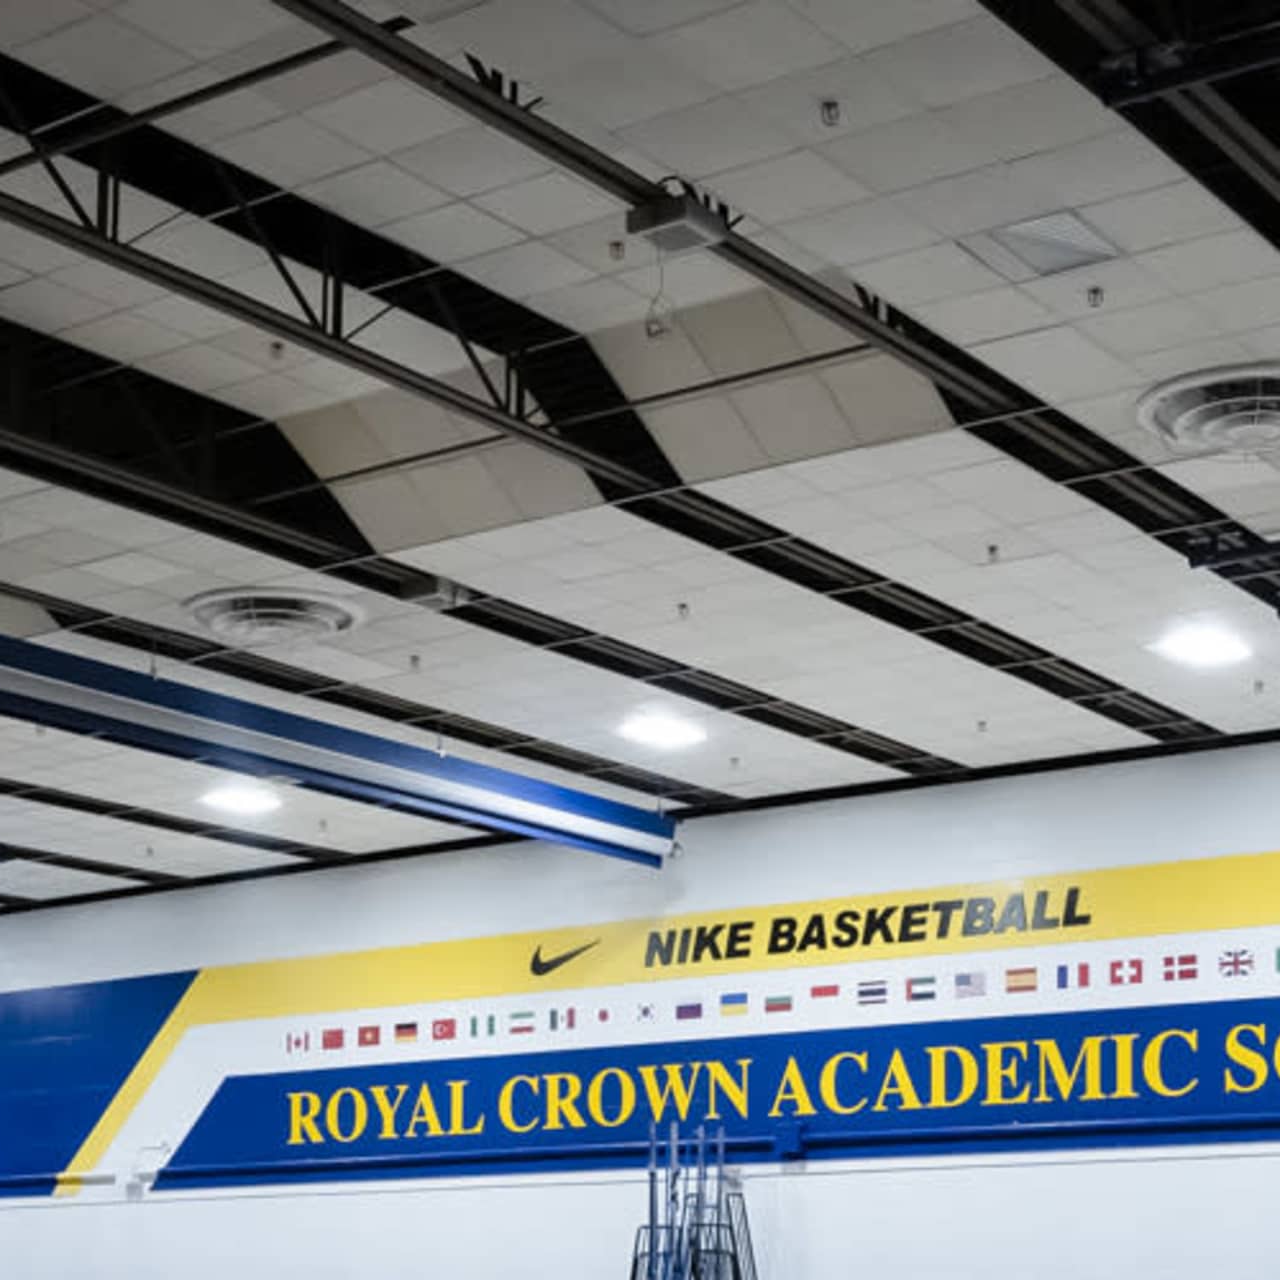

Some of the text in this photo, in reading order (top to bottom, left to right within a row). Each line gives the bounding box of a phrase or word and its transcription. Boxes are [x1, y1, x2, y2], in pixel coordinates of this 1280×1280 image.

[644, 887, 1091, 968] NIKE BASKETBALL
[286, 1080, 485, 1146] ROYAL
[497, 1059, 753, 1134] CROWN
[767, 1028, 1200, 1118] ACADEMIC
